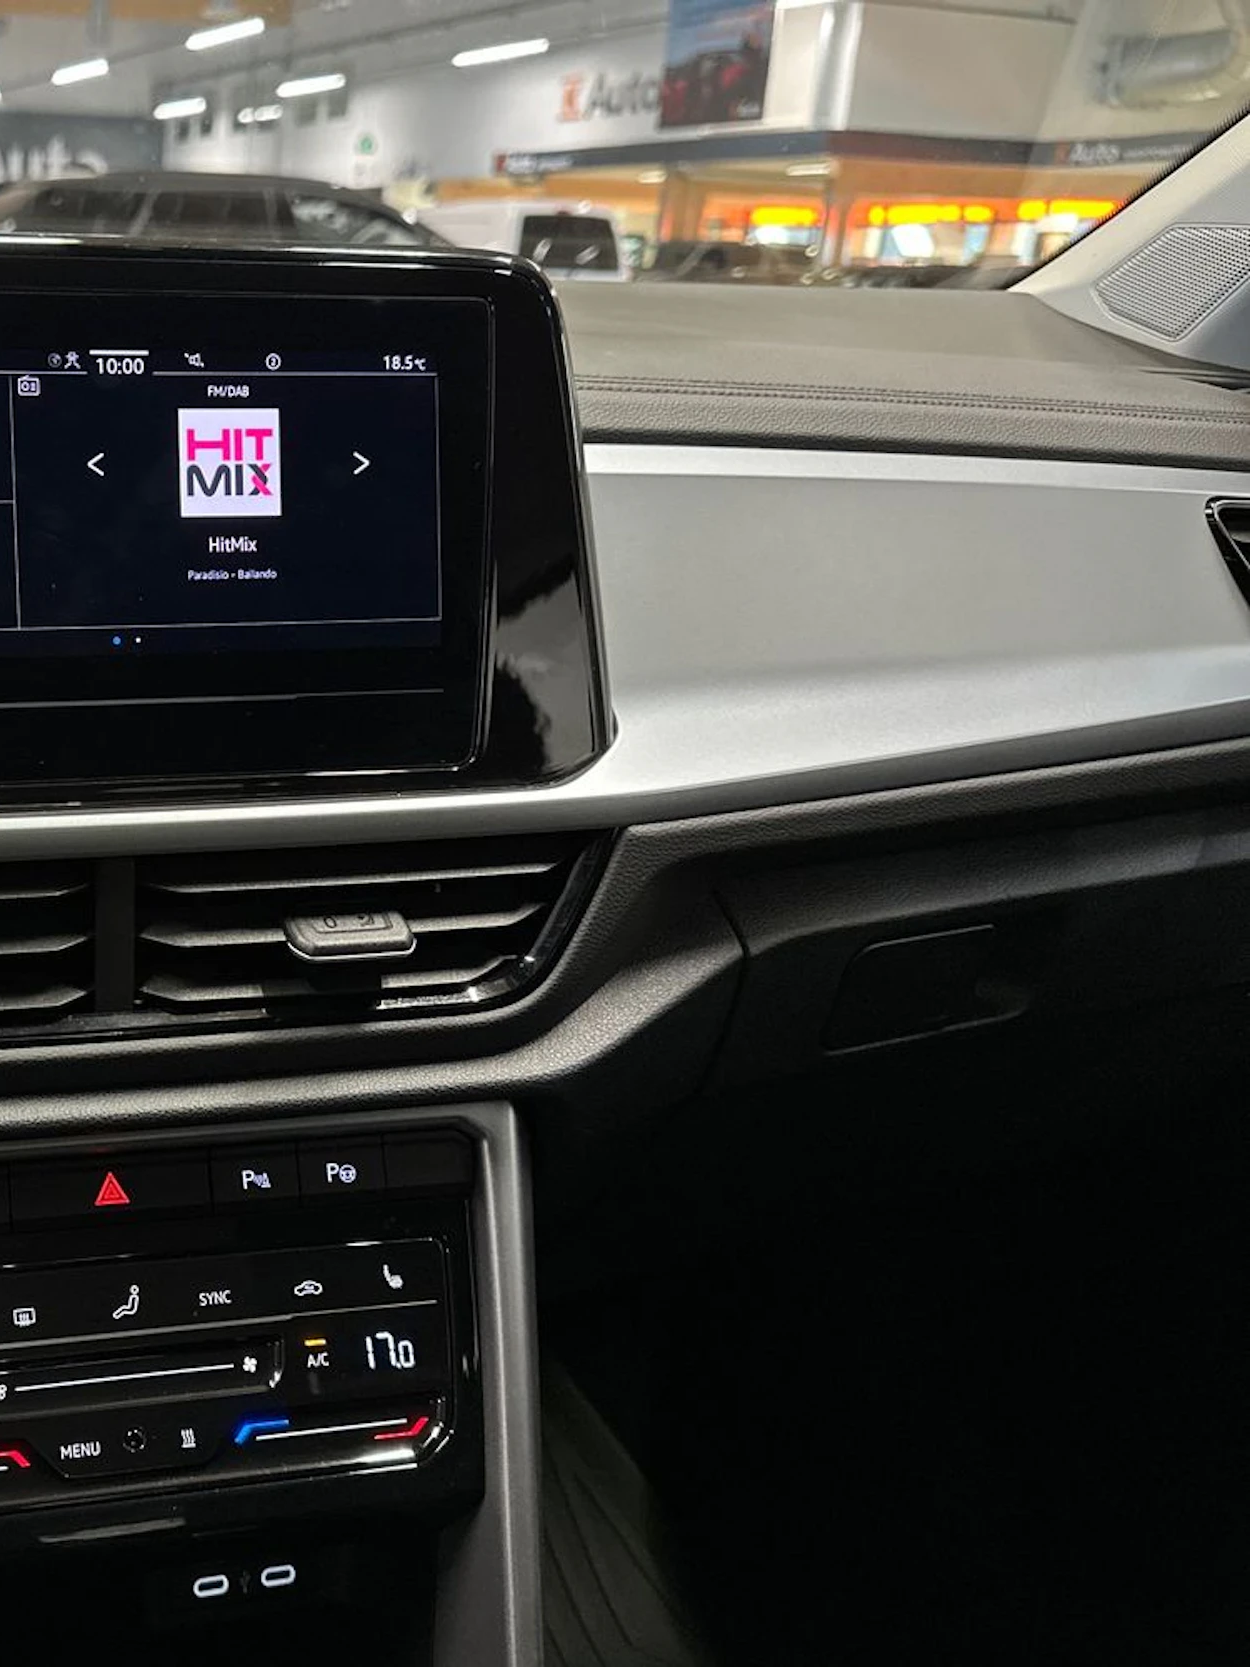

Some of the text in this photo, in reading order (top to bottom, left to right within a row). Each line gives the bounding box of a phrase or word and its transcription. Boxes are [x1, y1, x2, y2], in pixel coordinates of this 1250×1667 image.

[96, 357, 145, 375] 10:00
[383, 354, 426, 371] 18.5°C
[207, 384, 250, 398] FM/DAB
[187, 428, 274, 462] HIT
[187, 463, 273, 497] MIX
[208, 536, 258, 553] HitMix
[187, 569, 230, 580] Paradisio
[199, 1289, 233, 1307] SYNC
[306, 1352, 330, 1369] A/C
[59, 1441, 102, 1461] MENU
